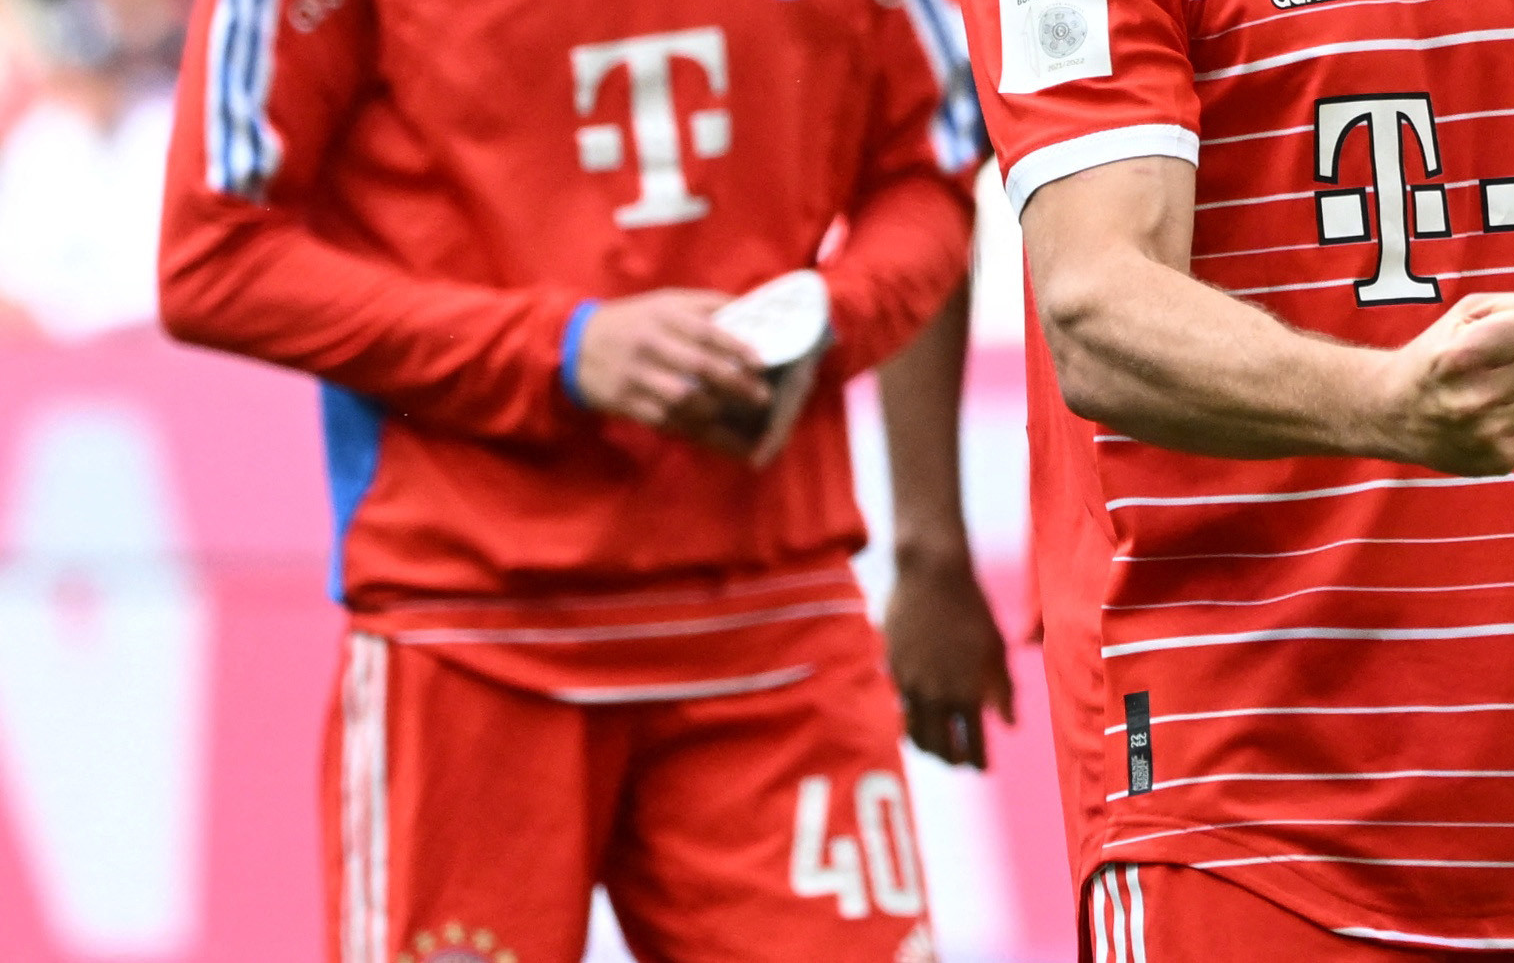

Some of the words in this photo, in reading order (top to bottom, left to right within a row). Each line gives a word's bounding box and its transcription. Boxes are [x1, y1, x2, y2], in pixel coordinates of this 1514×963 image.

[569, 24, 734, 230] T
[1314, 92, 1446, 308] T
[789, 768, 921, 920] 40
